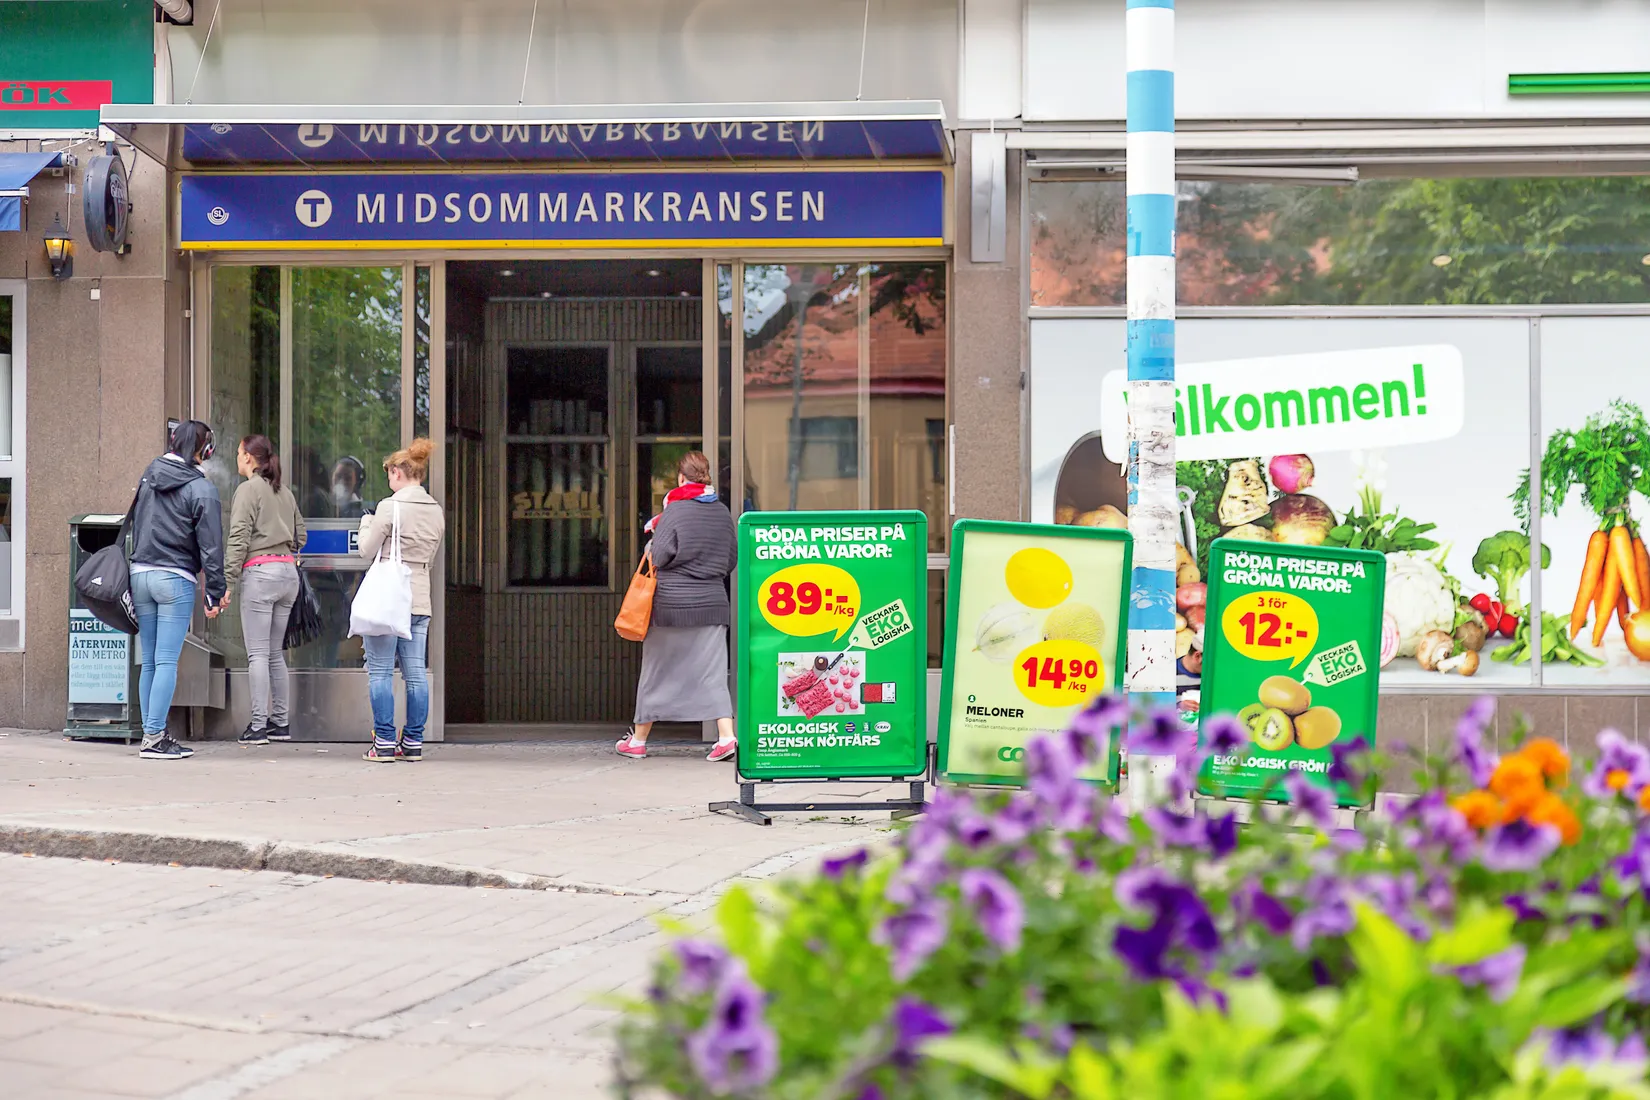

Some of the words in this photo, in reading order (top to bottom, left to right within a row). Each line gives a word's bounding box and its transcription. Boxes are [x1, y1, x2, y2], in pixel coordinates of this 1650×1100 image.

[356, 191, 825, 223] MIDSOMMARKRANSEN
[1123, 363, 1427, 438] lkommen!
[755, 525, 808, 543] RÖDA
[810, 527, 878, 542] PRISER
[880, 523, 906, 541] PÅ
[755, 542, 822, 560] GRÖNA
[824, 543, 893, 559] VAROR:
[1224, 550, 1274, 571] RÖDA
[1276, 557, 1339, 576] PRISER
[1341, 561, 1366, 579] PÅ
[1223, 567, 1285, 589] GRÖNA
[1287, 574, 1352, 594] VAROR:
[766, 581, 849, 617] 89:-
[833, 605, 855, 617] /kg
[1257, 597, 1265, 607] 3
[1269, 597, 1287, 609] för
[862, 603, 900, 626] VECKANS
[865, 611, 905, 638] EKO
[871, 623, 911, 647] LOGISKA
[1238, 612, 1308, 647] 12:-
[72, 637, 126, 649] ÅTERVINN
[72, 650, 88, 659] DIN
[92, 650, 126, 660] METRO
[1317, 644, 1355, 663] VECKANS
[1320, 652, 1358, 676] EKO
[1325, 664, 1364, 684] LOGISKA
[1067, 681, 1087, 693] /kg
[965, 716, 987, 724] Spanien
[966, 705, 1024, 719] MELONER
[758, 722, 839, 735] EKOLOGISK
[757, 736, 815, 748] SVENSK
[817, 733, 881, 747] NÖTFÄRS
[1213, 754, 1288, 771] EKOLOGISK
[1289, 759, 1326, 773] GRÖN
